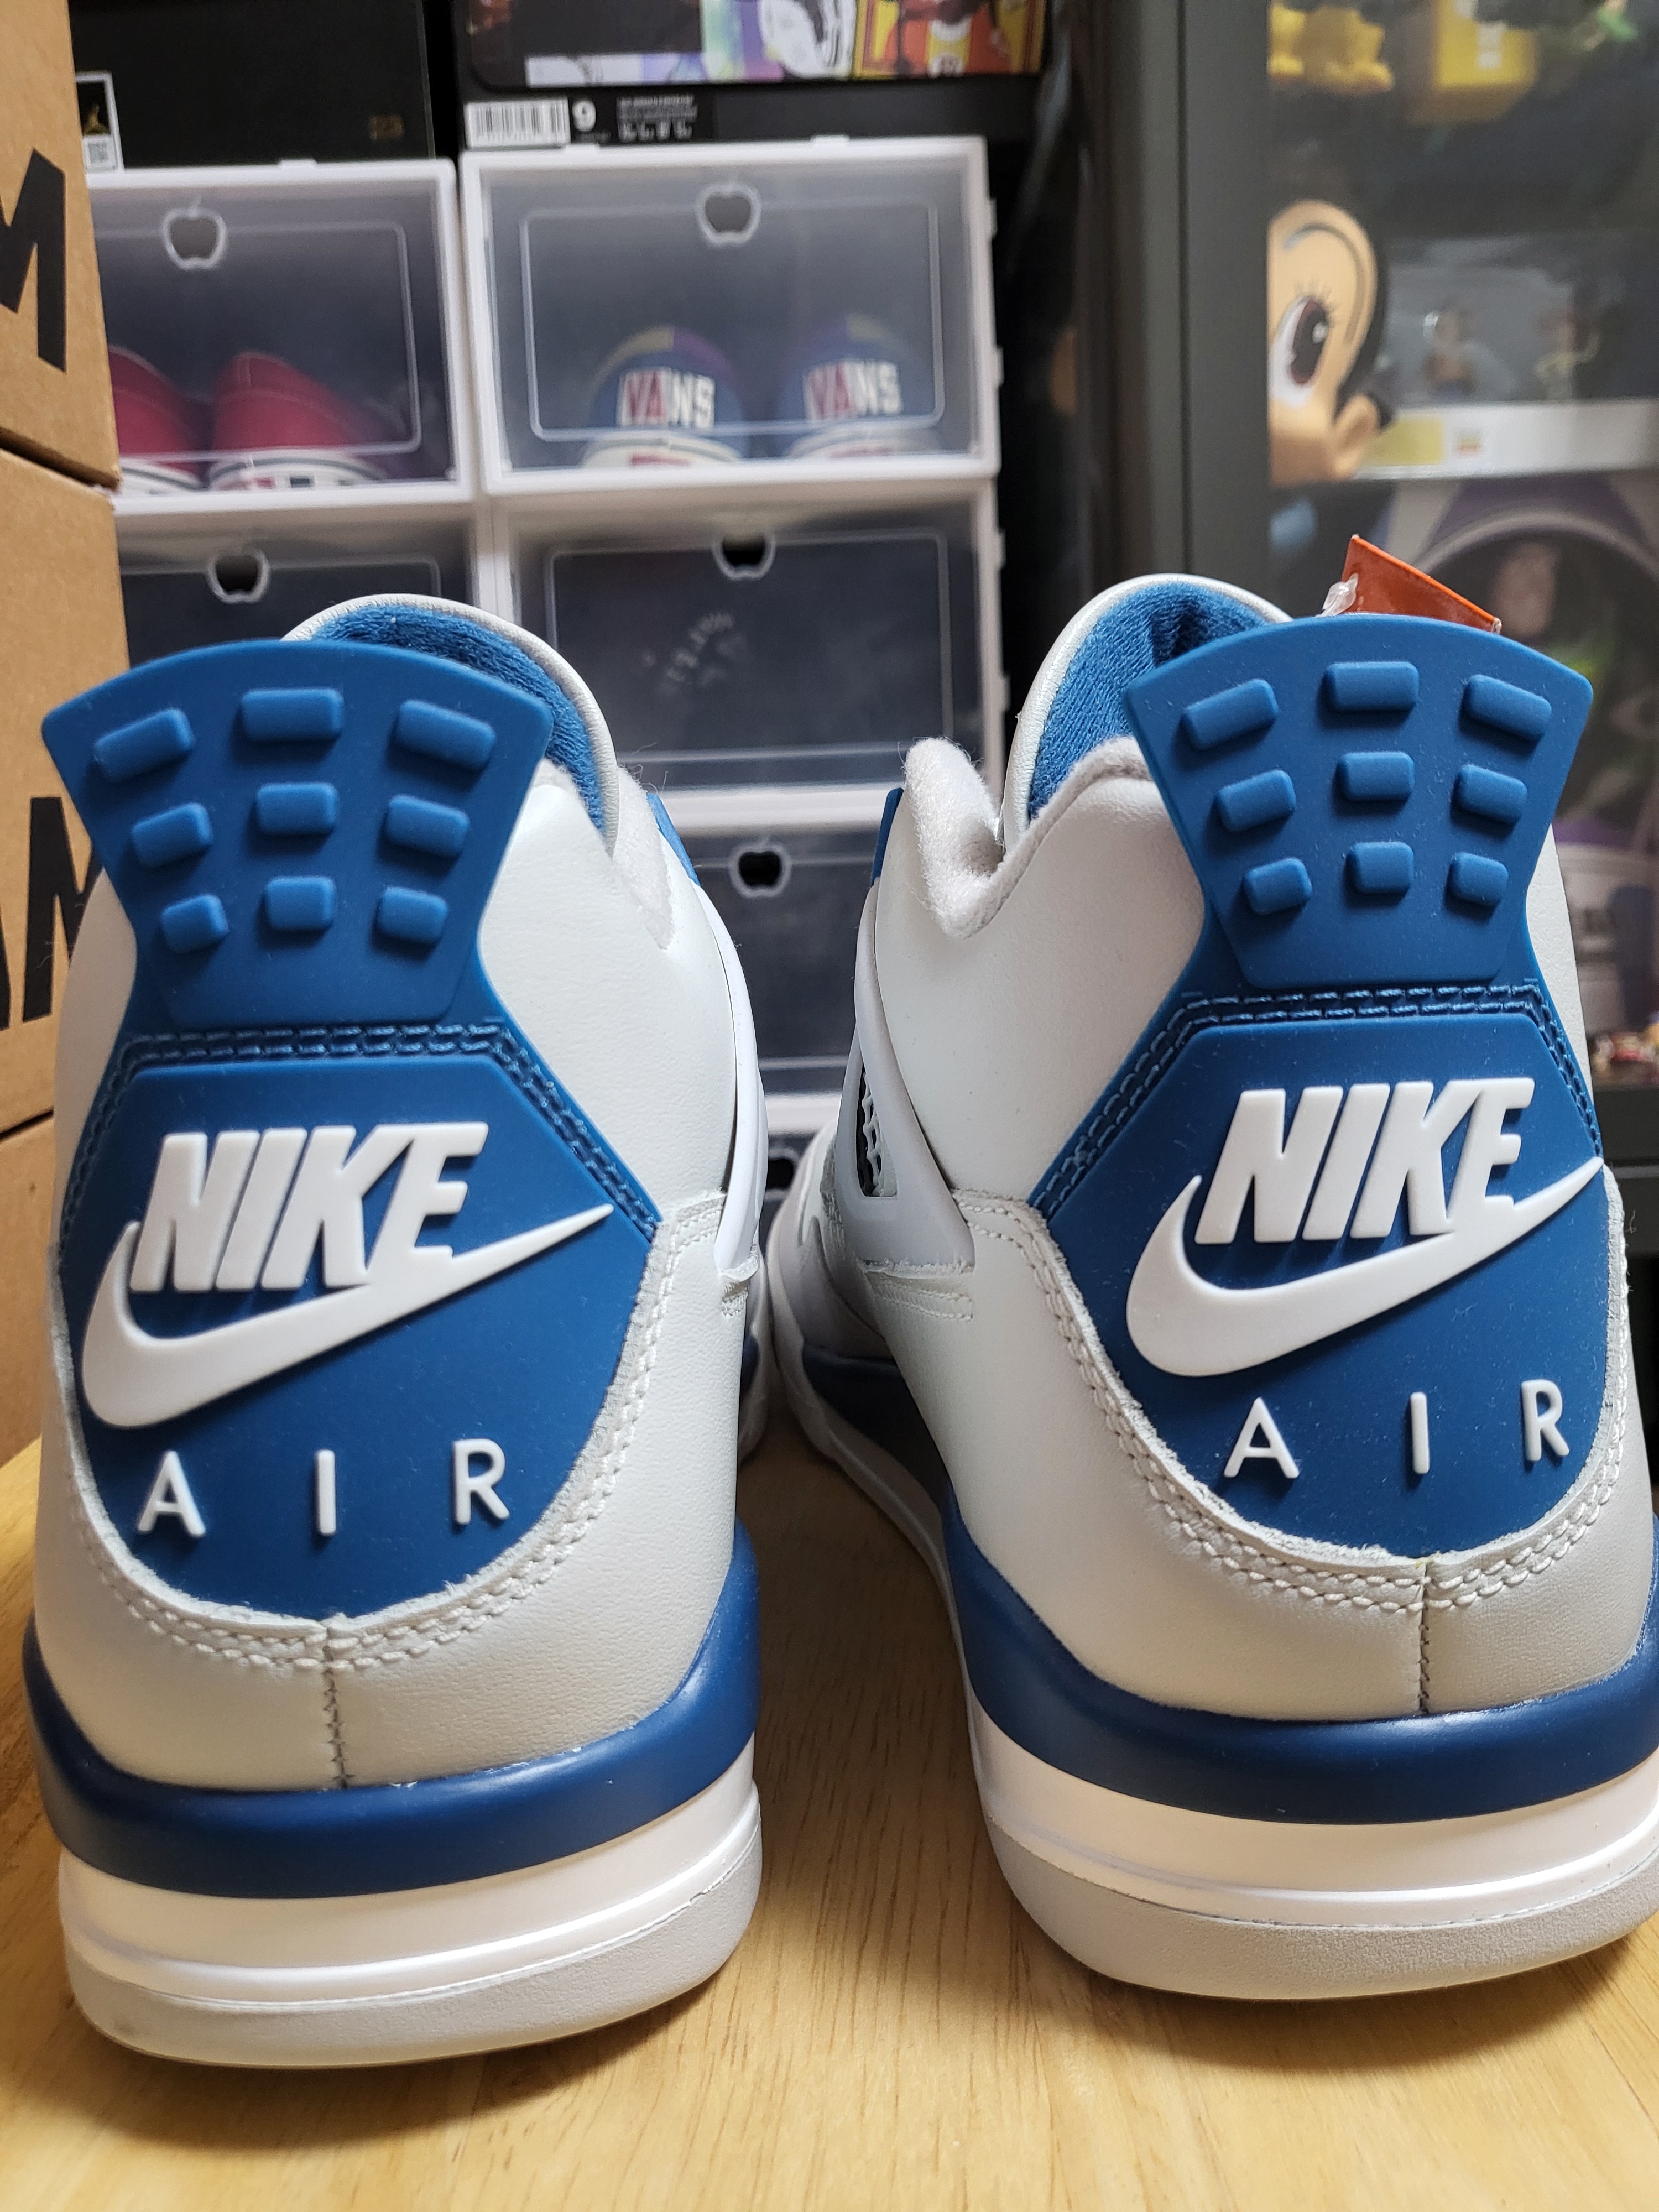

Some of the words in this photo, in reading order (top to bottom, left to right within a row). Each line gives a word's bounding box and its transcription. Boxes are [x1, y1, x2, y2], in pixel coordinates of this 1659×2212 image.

[617, 368, 715, 428] VANS
[804, 358, 902, 419] VANS
[131, 1122, 488, 1291] NIKE
[1194, 1078, 1535, 1244] NIKE
[1223, 1379, 1569, 1479] AIR
[137, 1438, 510, 1537] AIR
